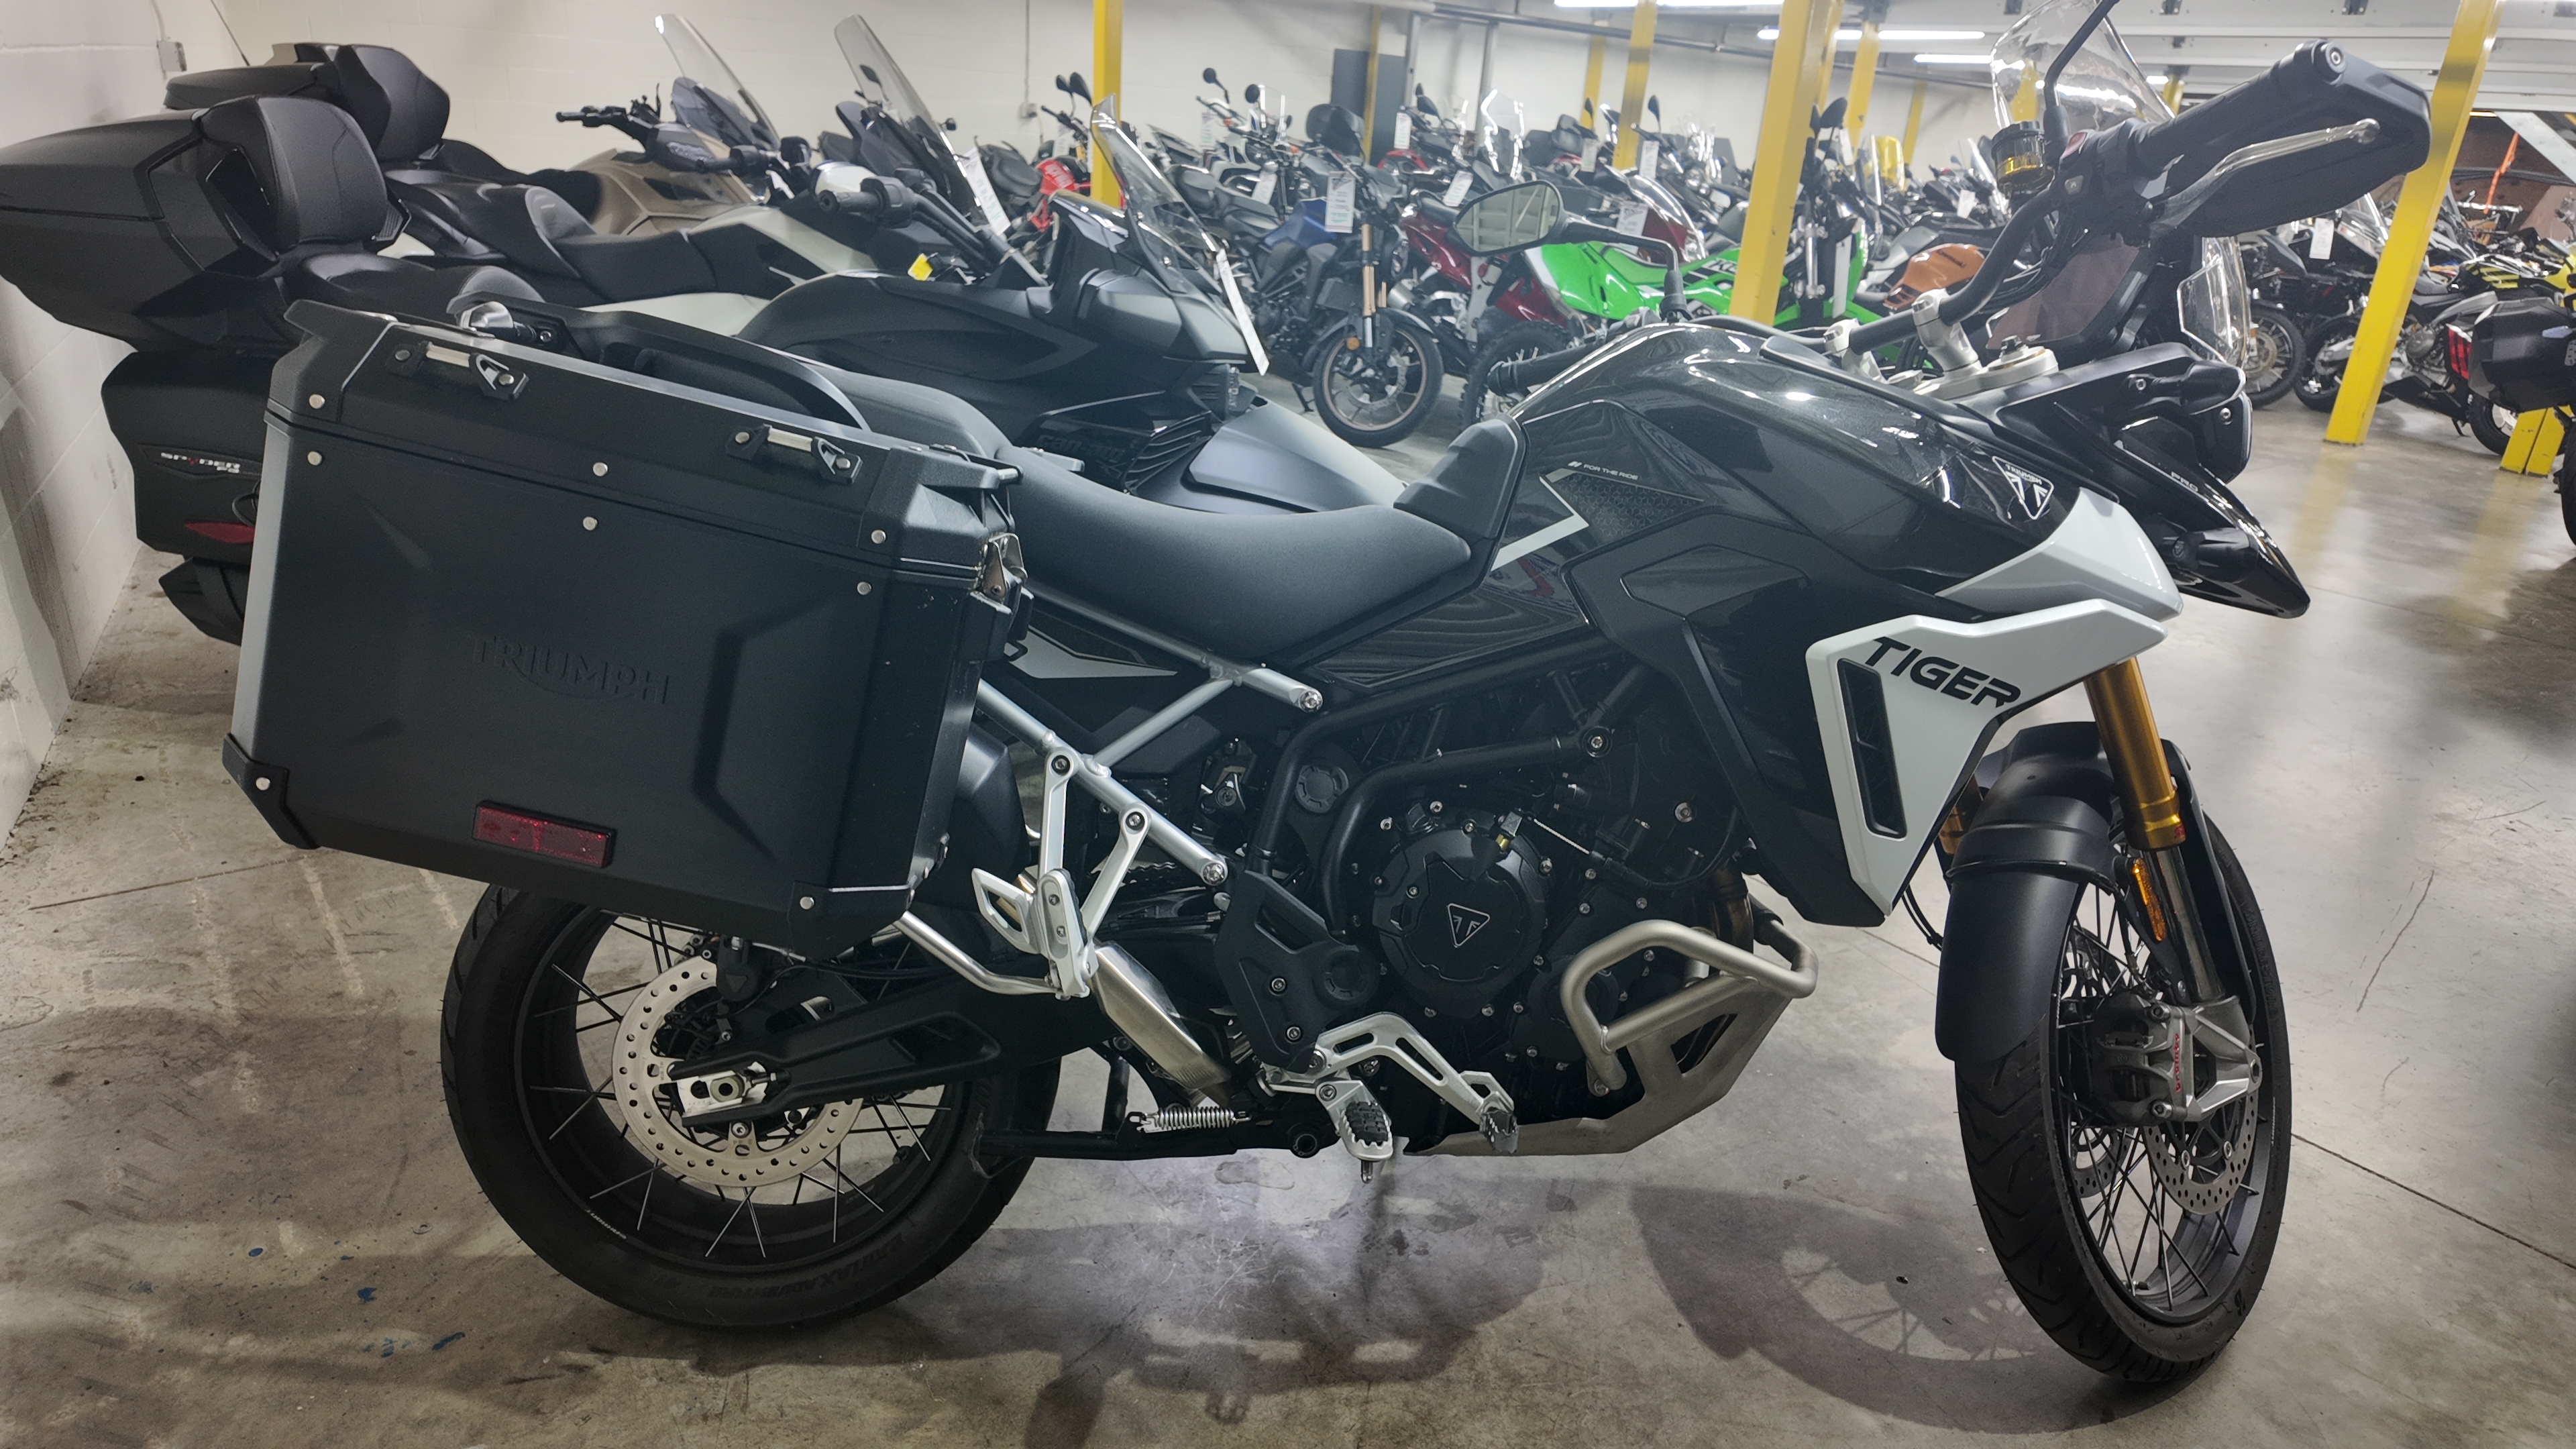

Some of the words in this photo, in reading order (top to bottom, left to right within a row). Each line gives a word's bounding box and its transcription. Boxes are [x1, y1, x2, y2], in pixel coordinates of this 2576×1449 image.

[1583, 464, 1601, 472] FOR
[1602, 468, 1618, 476] THE
[1619, 472, 1638, 480] RIDE
[2171, 471, 2198, 492] PRO
[467, 634, 669, 704] TRIUMPH
[1864, 636, 2021, 708] TIGER
